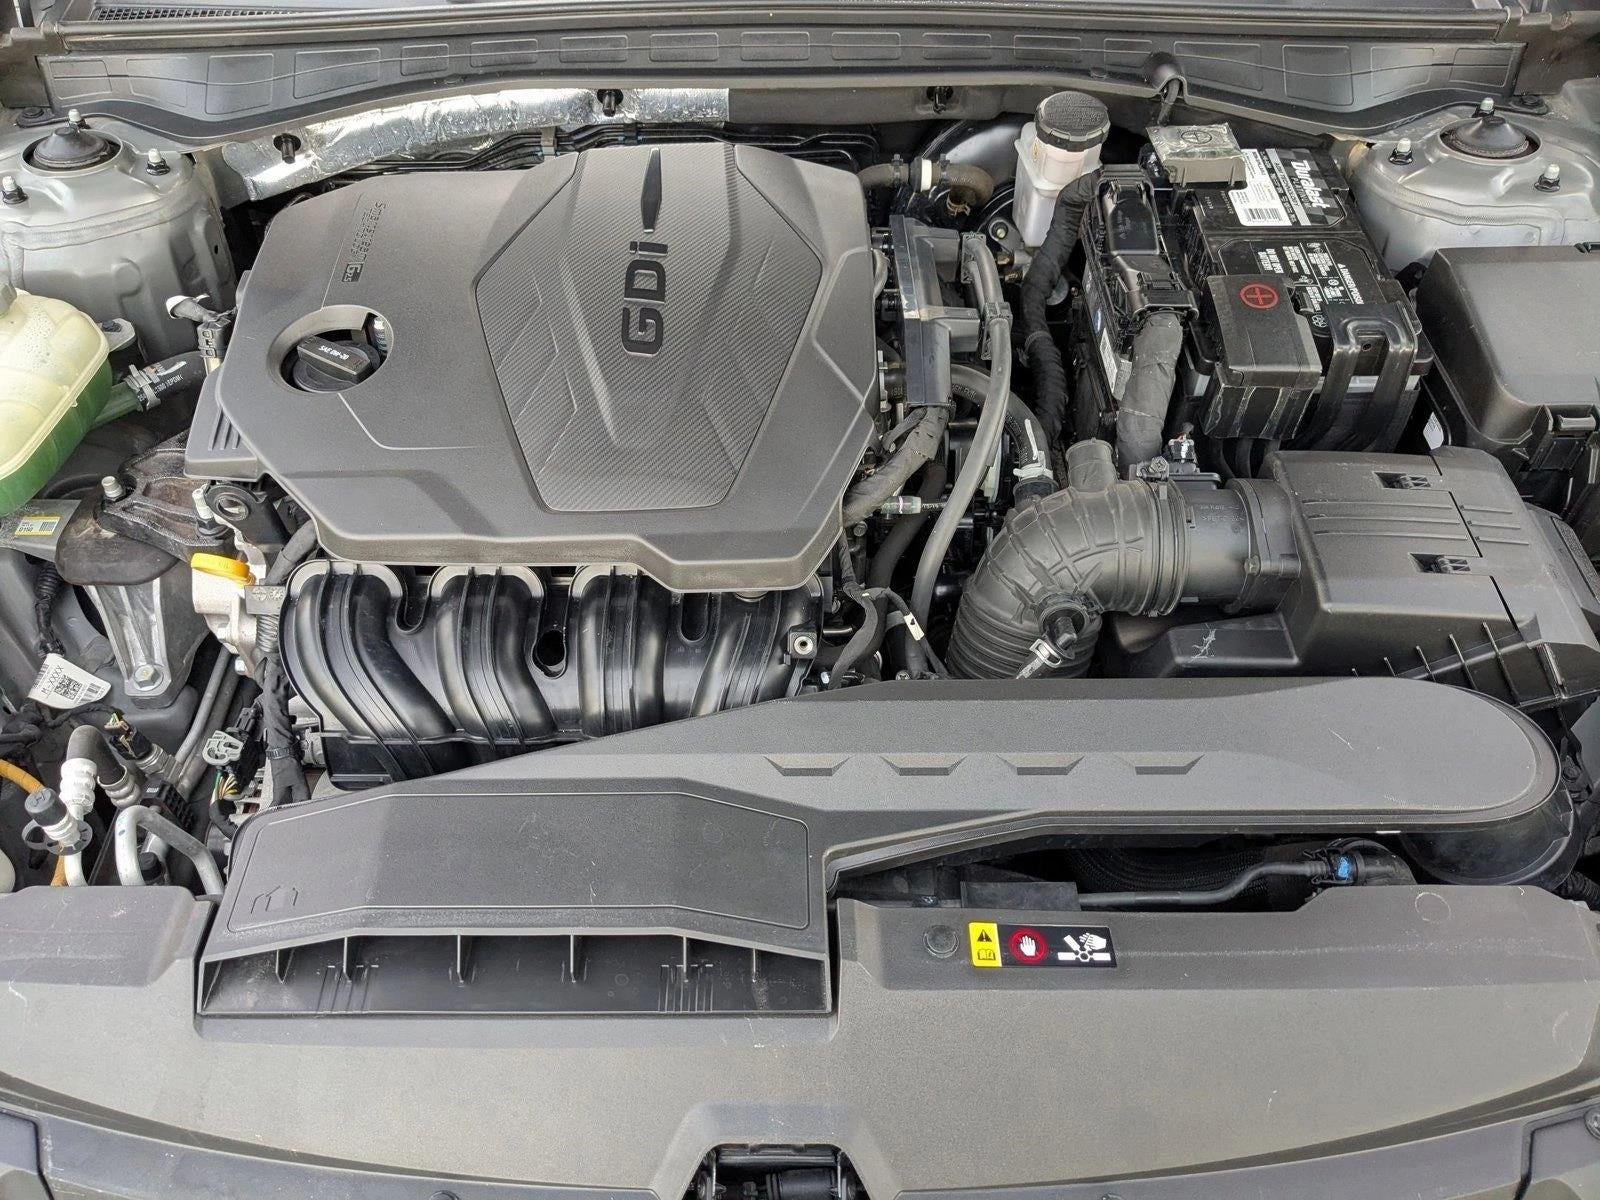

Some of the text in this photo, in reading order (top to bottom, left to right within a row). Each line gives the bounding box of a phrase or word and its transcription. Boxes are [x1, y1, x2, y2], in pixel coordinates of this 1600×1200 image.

[1291, 160, 1330, 208] Duralast
[1291, 177, 1312, 208] PLATINUM
[621, 241, 668, 358] GDi
[318, 345, 350, 360] SAE 0W-20
